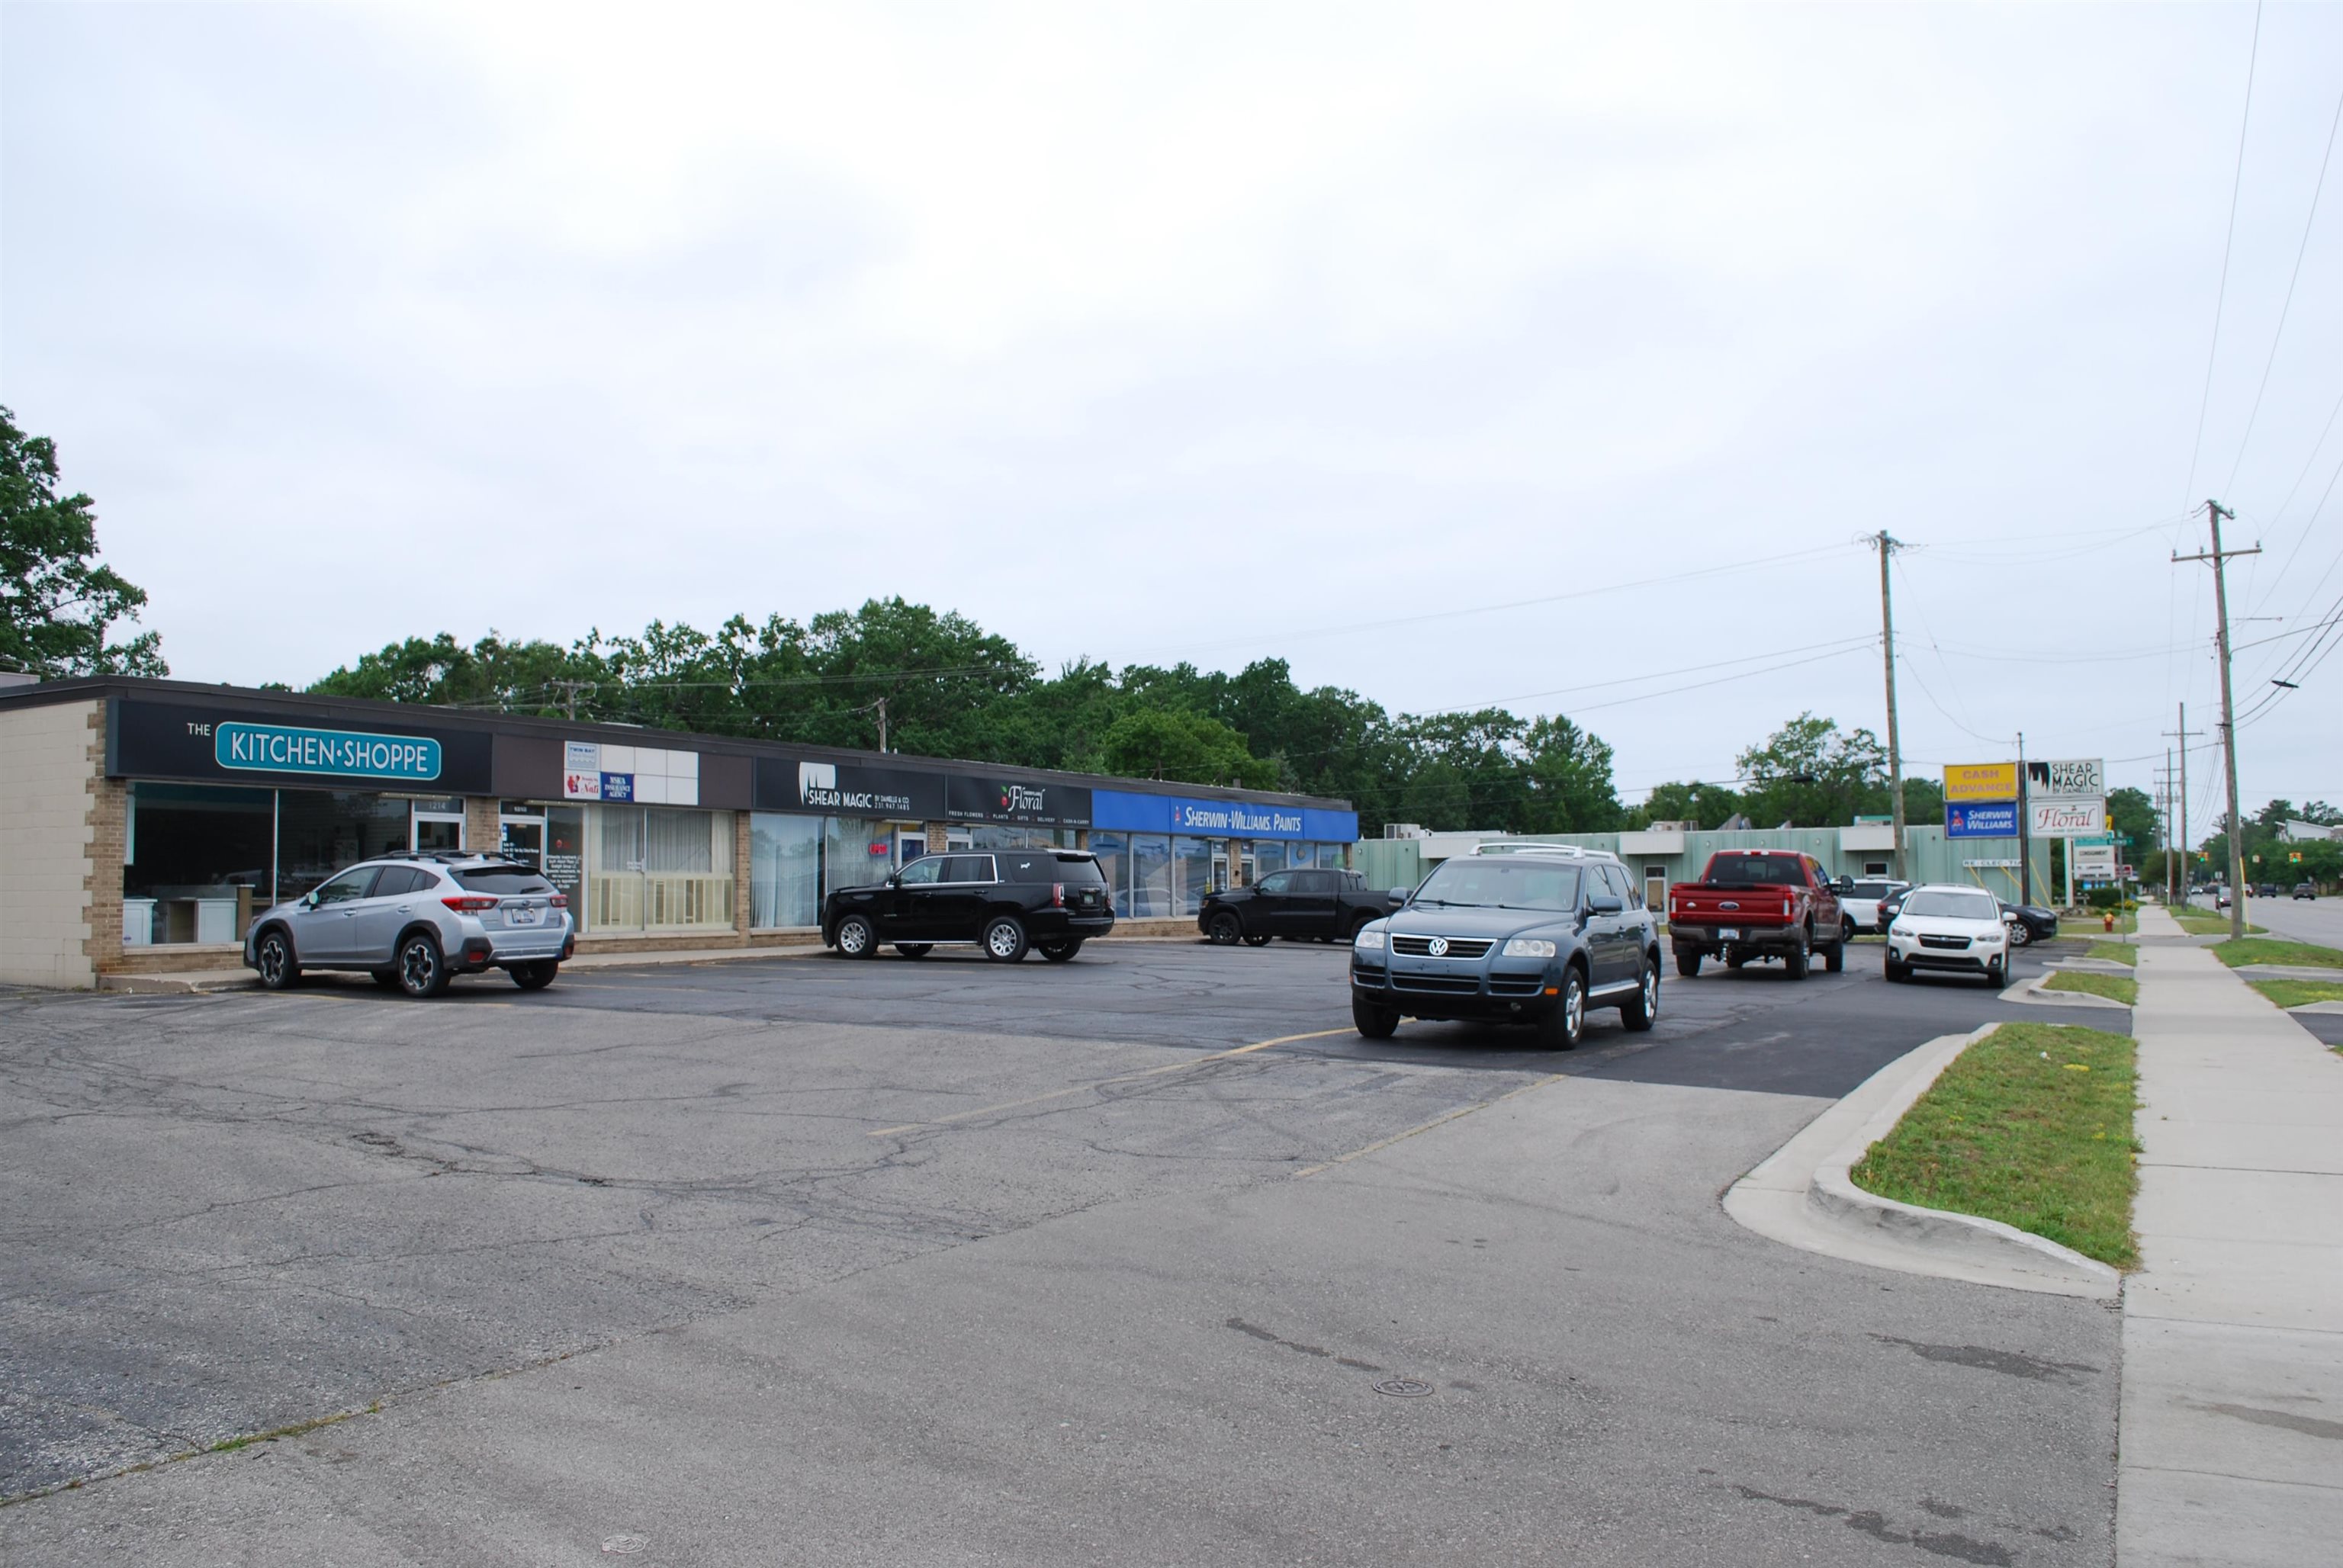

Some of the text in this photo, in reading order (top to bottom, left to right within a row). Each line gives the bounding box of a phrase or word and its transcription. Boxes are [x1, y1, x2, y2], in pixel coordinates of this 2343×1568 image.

[187, 722, 211, 737] THE
[2052, 763, 2093, 774] SHEAR
[1962, 770, 2000, 779] CASH
[2052, 773, 2099, 787] MAGIC
[604, 784, 631, 792] INSURANCE
[1950, 782, 2012, 793] ADVANCE
[808, 789, 840, 806] SHEAR
[843, 792, 872, 808] MAGIC
[1008, 785, 1046, 812] Floral
[1968, 810, 2013, 820] SHERWIN
[2037, 808, 2096, 829] Floral
[1273, 813, 1301, 832] PAINTS
[1967, 820, 2014, 830] WILLIAMS
[869, 844, 888, 855] OPEN
